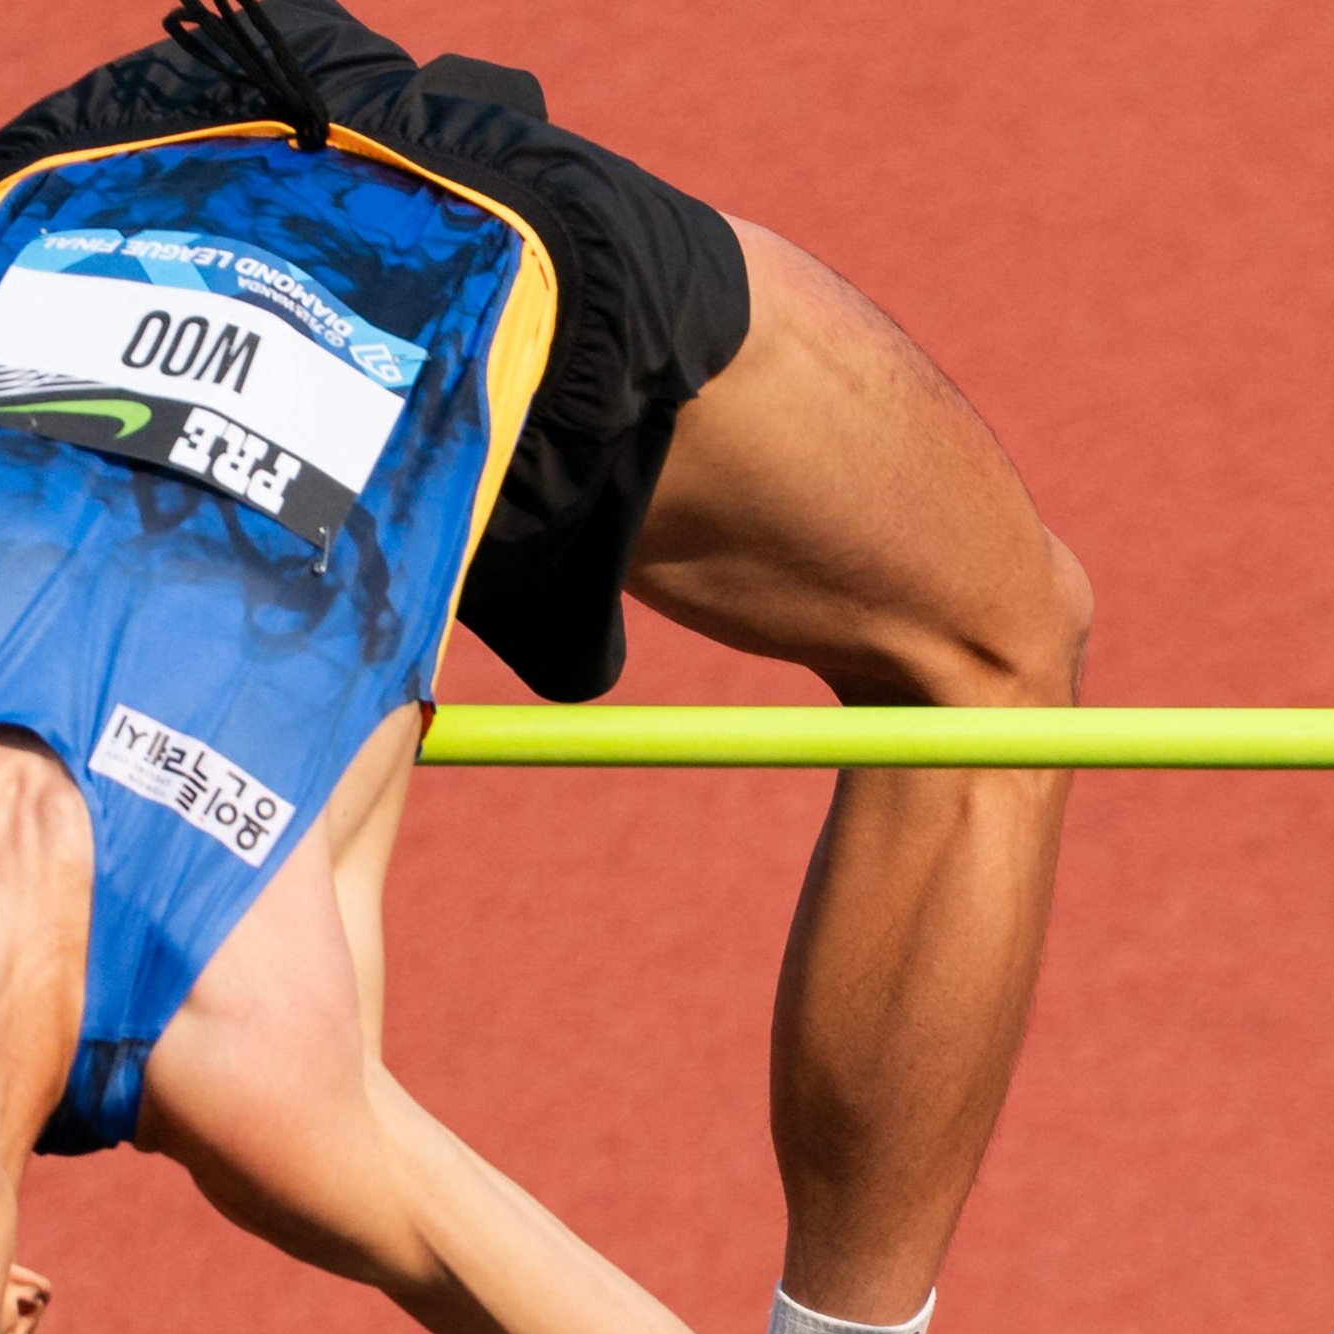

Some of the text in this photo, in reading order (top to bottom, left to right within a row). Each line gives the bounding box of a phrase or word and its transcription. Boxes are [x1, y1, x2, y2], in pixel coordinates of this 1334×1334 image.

[42, 236, 354, 339] DIAMOND LEAGUE FINAL
[121, 310, 261, 394] WOO
[168, 407, 302, 515] PRE
[114, 714, 277, 851] 용인특례시
